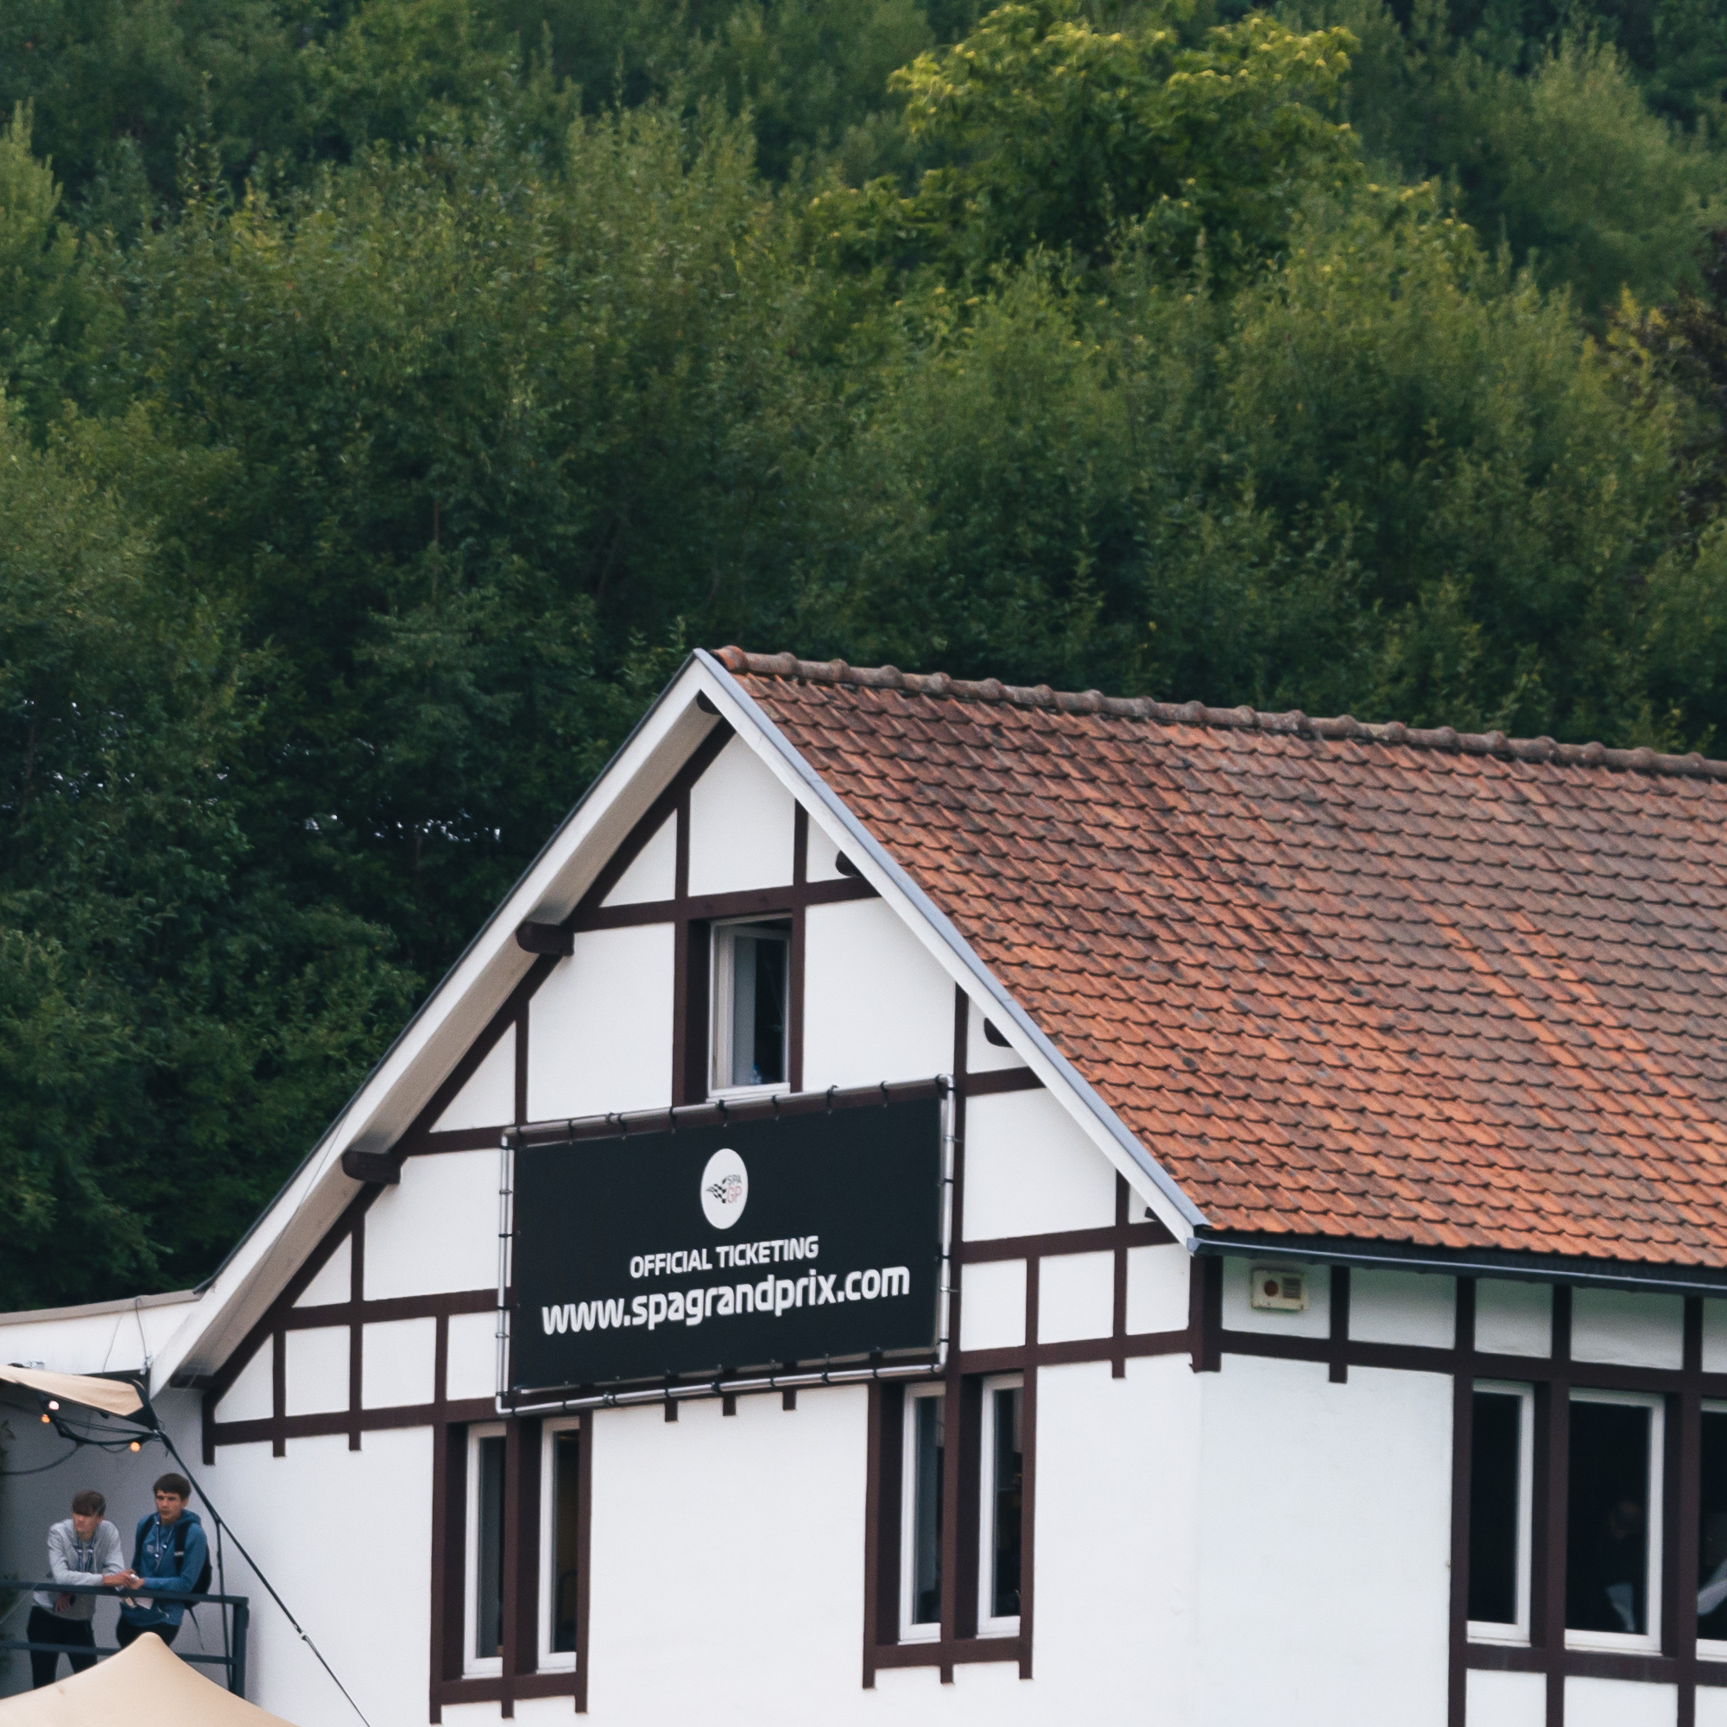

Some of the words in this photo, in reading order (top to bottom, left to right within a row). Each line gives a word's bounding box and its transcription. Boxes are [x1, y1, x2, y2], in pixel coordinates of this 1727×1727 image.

[630, 1249, 712, 1278] OFFICIAL
[716, 1236, 818, 1268] TICKETING
[541, 1265, 910, 1336] www.spagrandprix.com
